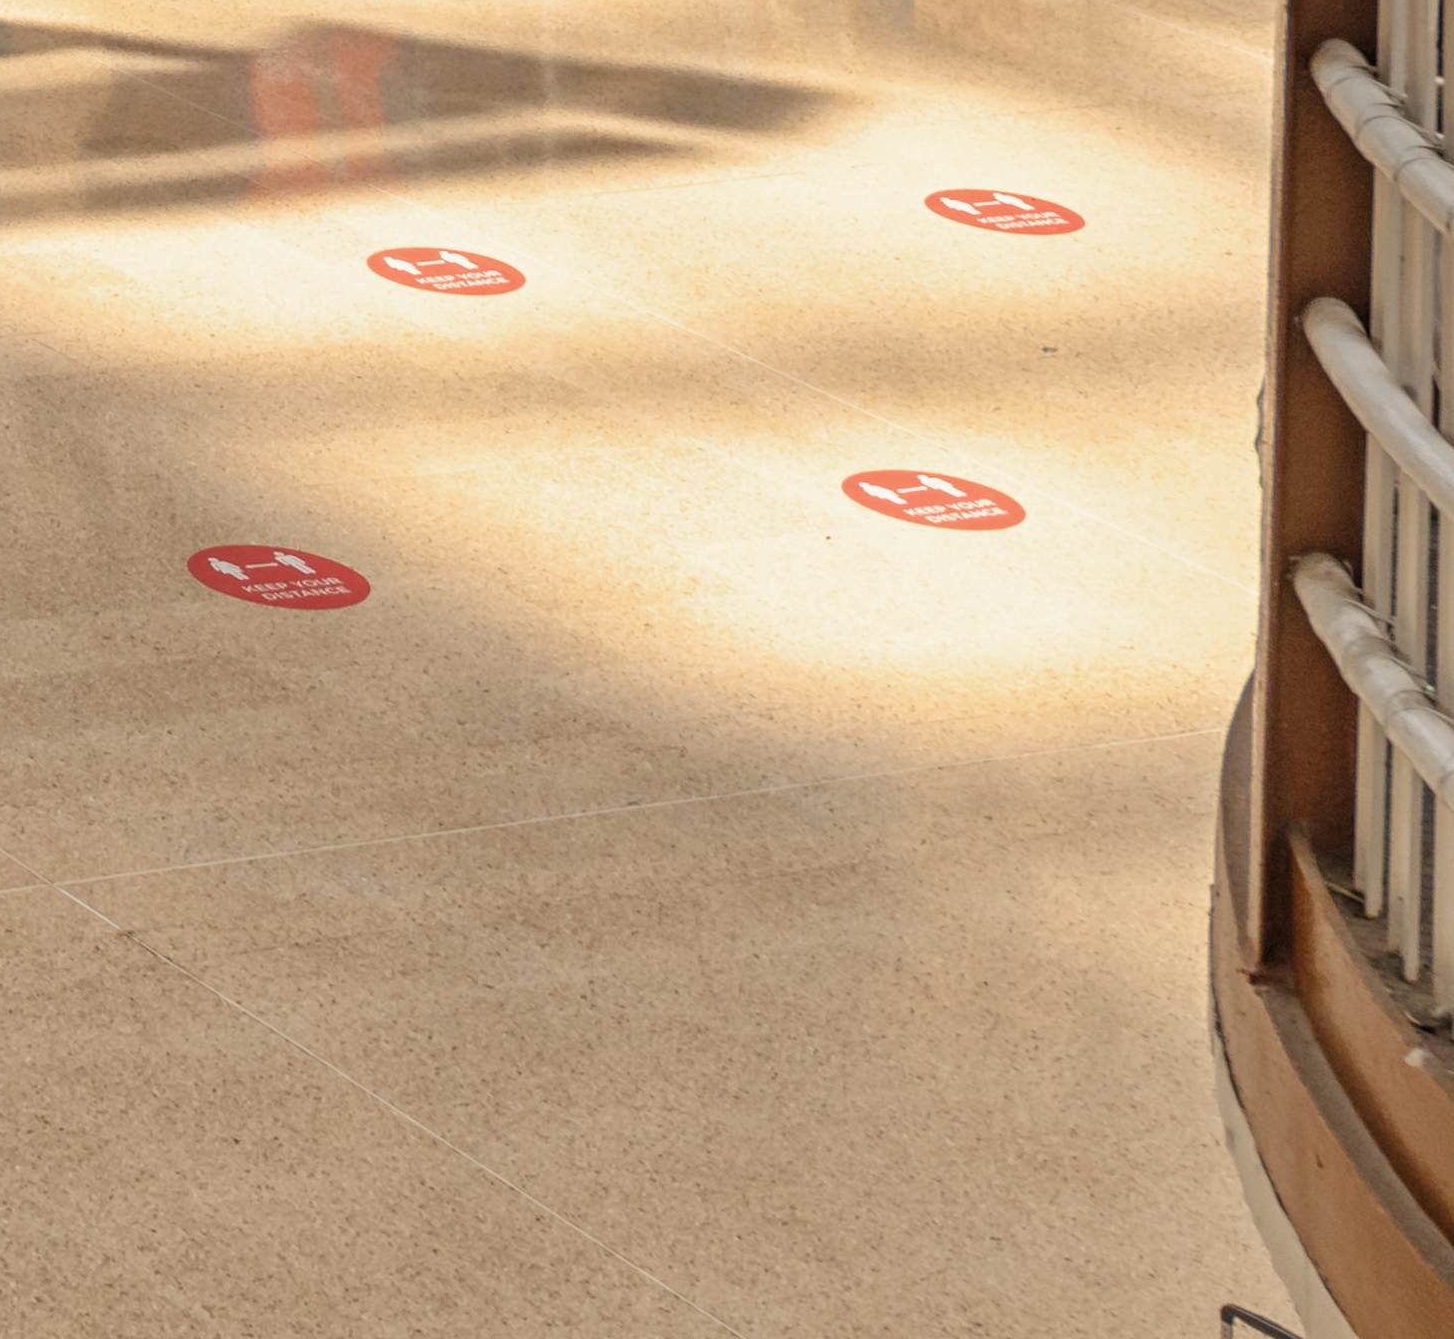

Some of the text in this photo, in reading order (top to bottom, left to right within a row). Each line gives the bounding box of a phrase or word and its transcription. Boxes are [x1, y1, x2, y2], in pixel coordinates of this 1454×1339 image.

[242, 577, 342, 592] KEEP YOUR
[262, 586, 351, 600] DISTANCE
